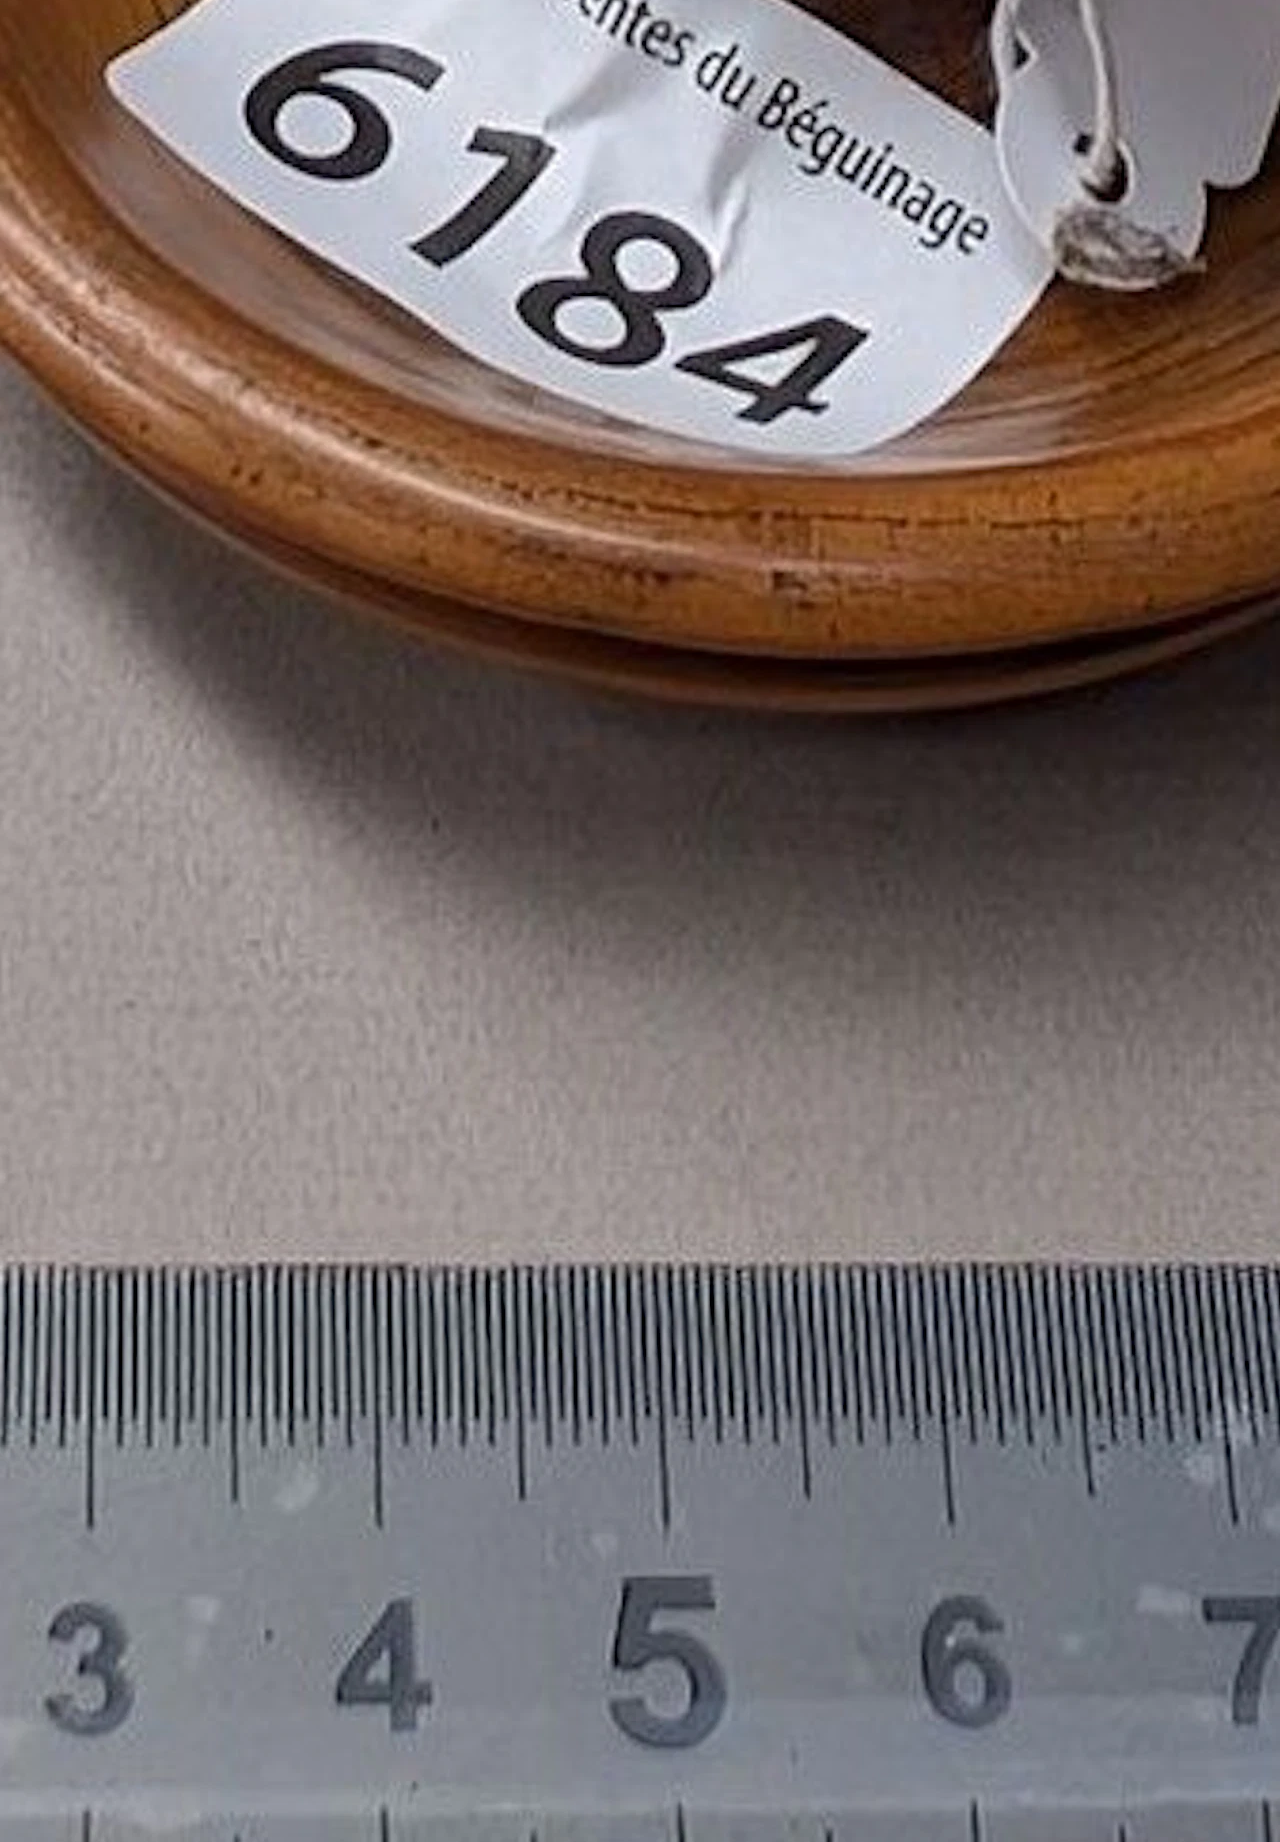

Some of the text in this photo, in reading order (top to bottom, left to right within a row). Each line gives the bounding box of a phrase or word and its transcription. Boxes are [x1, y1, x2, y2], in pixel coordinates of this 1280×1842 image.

[243, 39, 871, 426] 6184
[694, 43, 757, 112] du
[756, 77, 990, 256] Béguinage
[44, 1601, 133, 1737] 3
[334, 1598, 433, 1731] 4
[610, 1575, 726, 1749] 5
[919, 1595, 1011, 1729] 6
